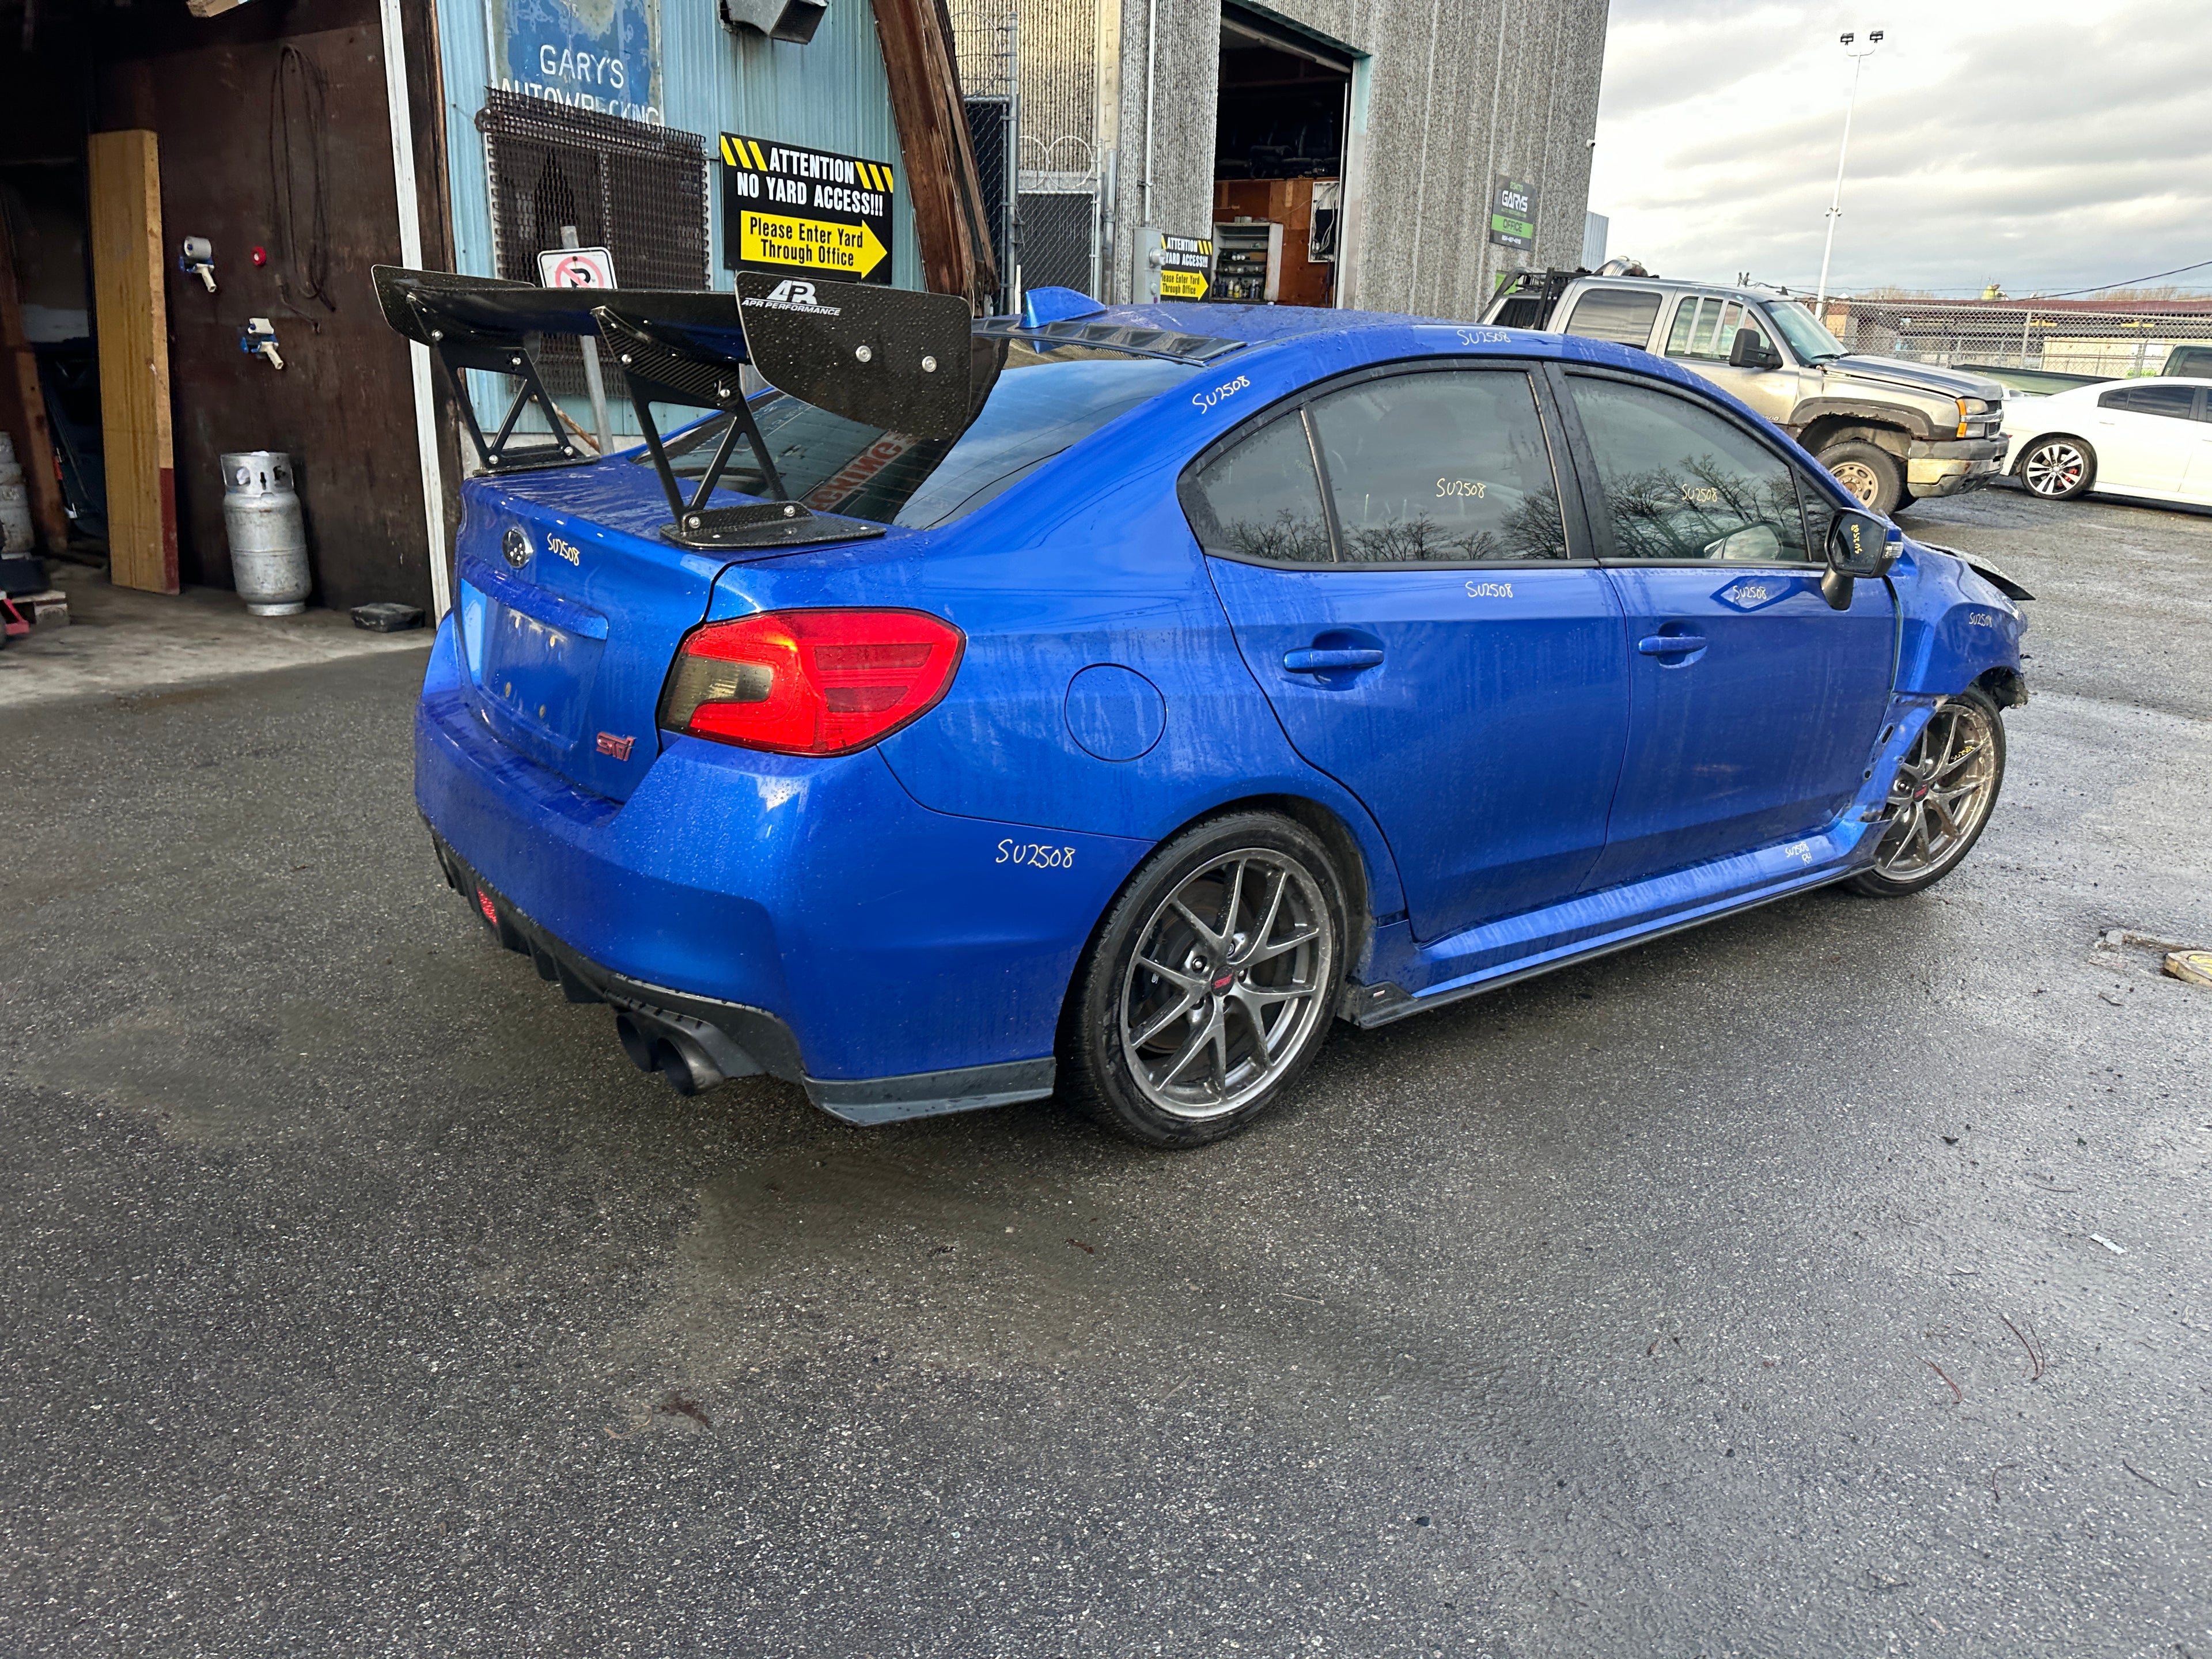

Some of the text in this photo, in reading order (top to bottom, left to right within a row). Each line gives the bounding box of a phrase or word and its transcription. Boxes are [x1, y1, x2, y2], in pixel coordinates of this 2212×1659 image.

[540, 44, 624, 88] GARY'S
[770, 147, 854, 184] ATTENTION
[737, 172, 883, 217] NO YARD ACCESS!!!
[750, 217, 863, 248] Please Enter Yard
[1503, 218, 1523, 232] OFFICE
[760, 238, 854, 266] Through Office
[1167, 237, 1198, 252] ATTENTION
[1166, 252, 1209, 268] YARD ACCESS!!!
[1161, 272, 1200, 285] lease Enter Yard
[1162, 283, 1196, 295] Through Office
[741, 300, 842, 316] APR PERFORMANCE
[1457, 329, 1512, 345] SU2508
[1192, 376, 1251, 414] SU2508
[1436, 478, 1487, 498] SU2508
[1682, 484, 1718, 502] SU2508
[1851, 524, 1863, 554] SU2508
[547, 532, 580, 566] SU2508
[1465, 581, 1513, 598] SU2508
[1733, 585, 1767, 600] SU2508
[995, 839, 1076, 869] SU2508
[1785, 841, 1809, 858] SU2508
[1801, 853, 1813, 866] RH
